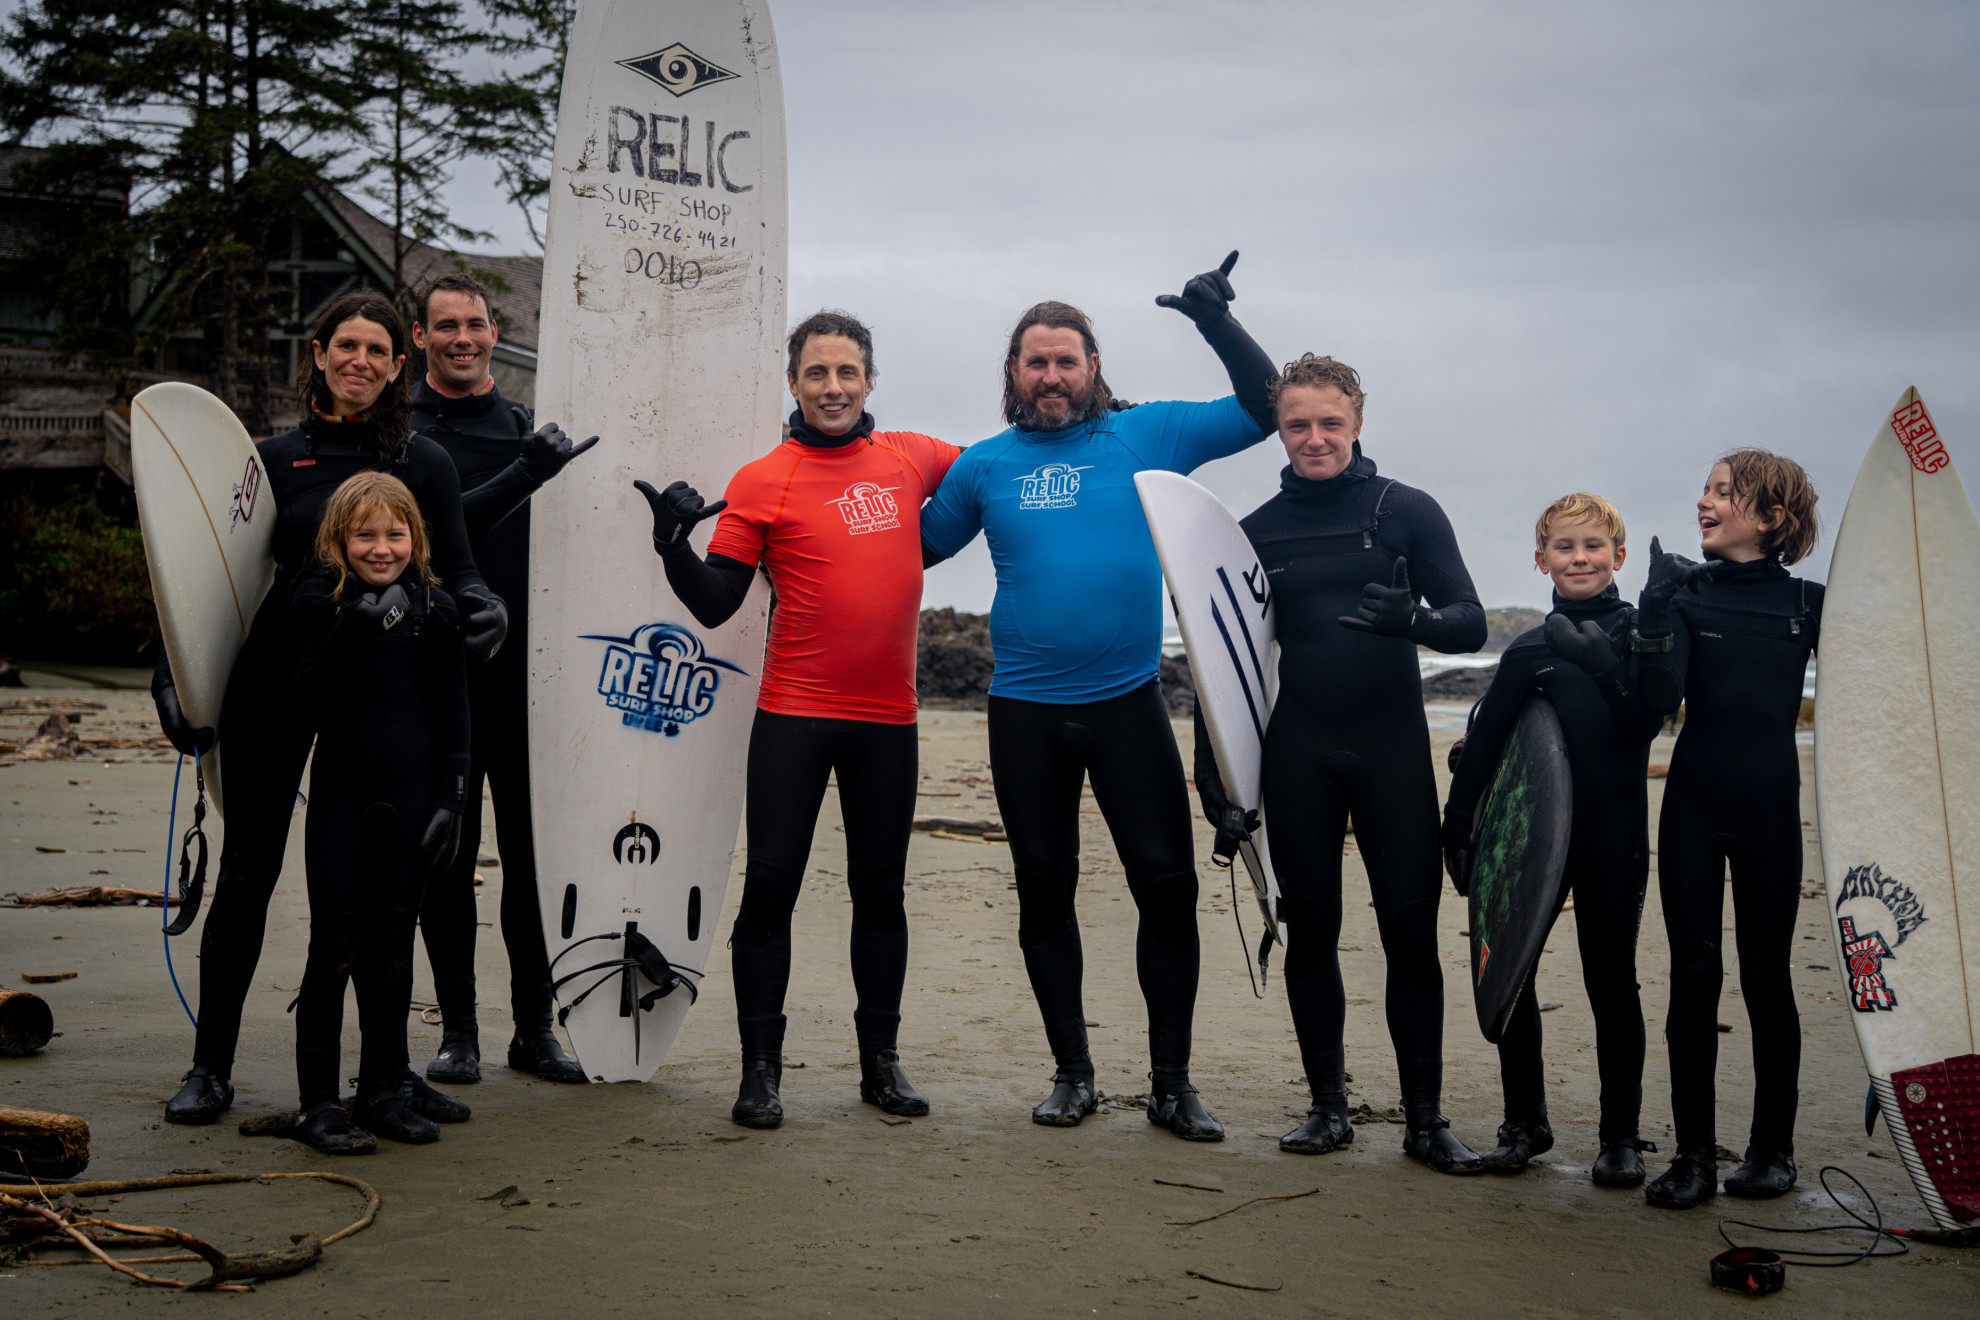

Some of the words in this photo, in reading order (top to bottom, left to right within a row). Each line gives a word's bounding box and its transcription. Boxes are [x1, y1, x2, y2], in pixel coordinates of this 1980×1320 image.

[607, 105, 754, 194] RELIC
[599, 184, 665, 214] SURF
[680, 196, 733, 227] SHOP
[604, 212, 737, 250] 250-726-4421
[1894, 400, 1949, 474] RELIC
[1021, 472, 1080, 499] RELIC
[1048, 493, 1072, 501] SHOP
[838, 492, 898, 525] RELIC
[873, 514, 895, 523] SHOP
[1043, 499, 1077, 508] SCHOOL
[849, 526, 870, 534] SURF
[871, 520, 900, 531] SCHOOL
[599, 646, 719, 717] RELIC
[607, 693, 648, 713] SURF
[652, 703, 696, 724] SHOP
